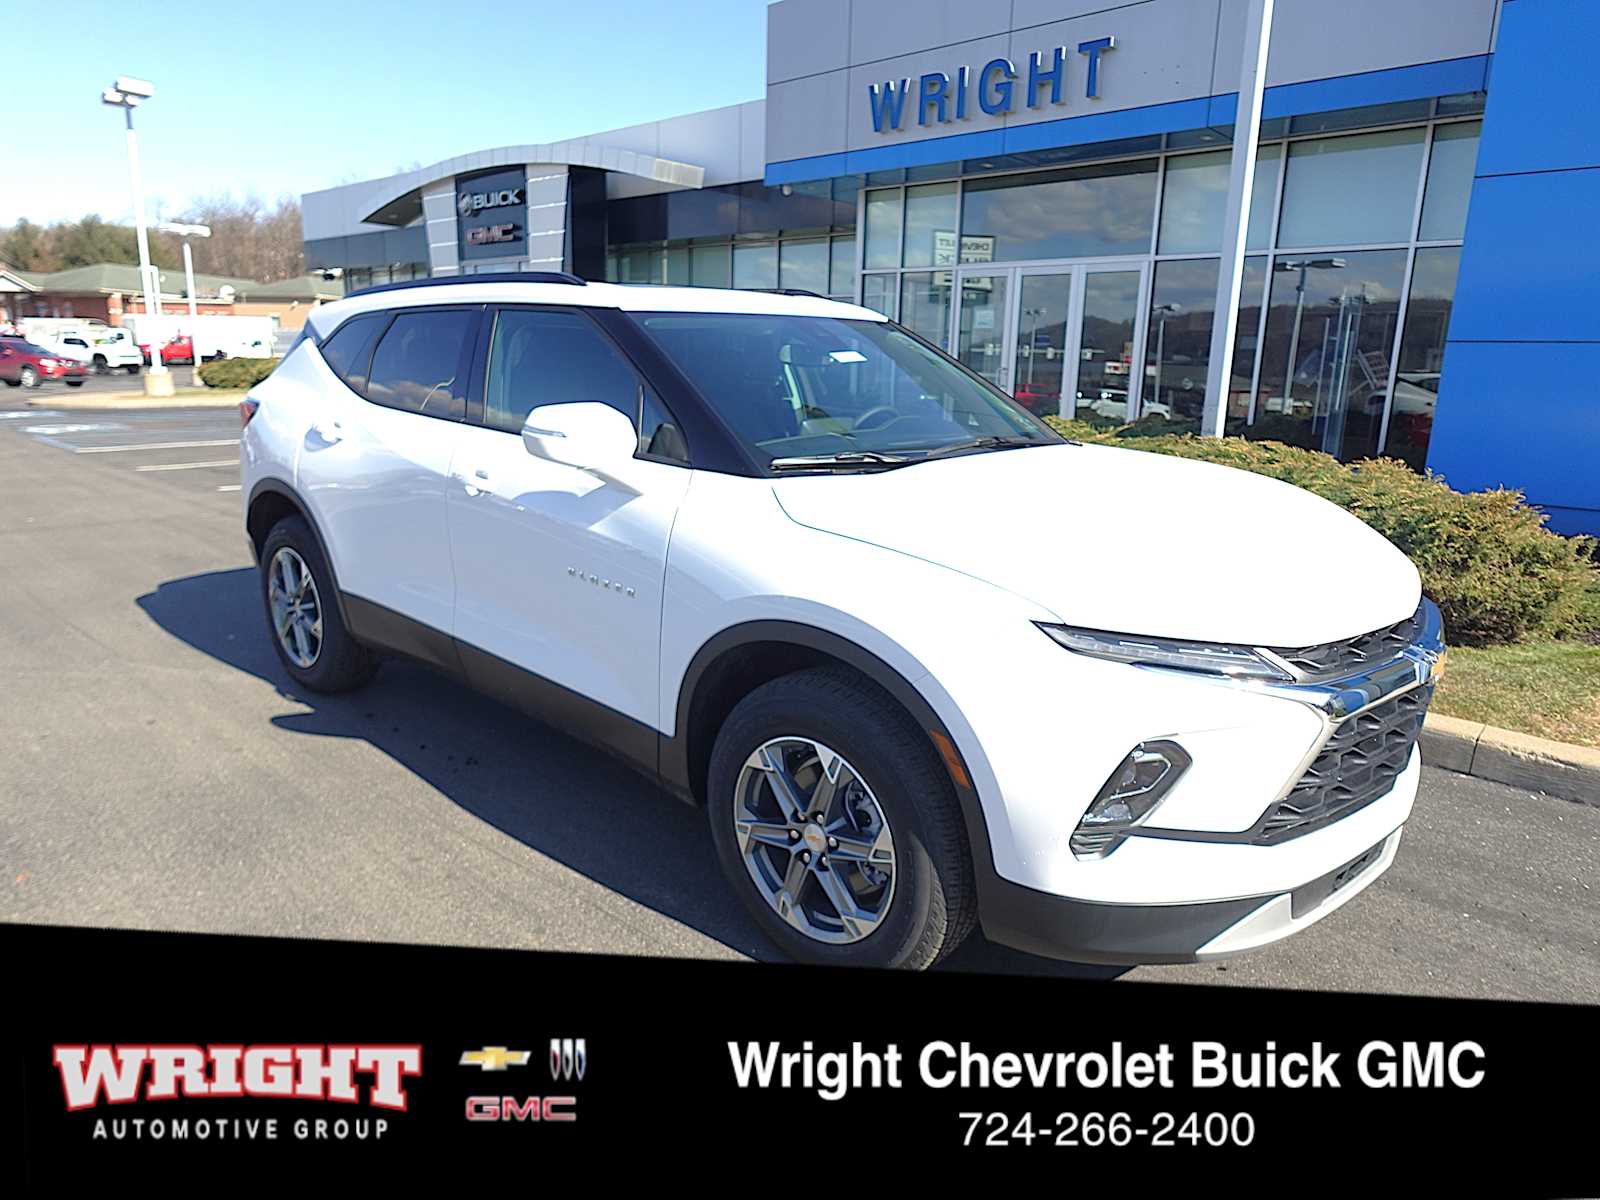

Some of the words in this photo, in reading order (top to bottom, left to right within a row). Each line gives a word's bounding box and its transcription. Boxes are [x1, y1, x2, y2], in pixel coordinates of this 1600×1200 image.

[868, 36, 1115, 132] WRIGHT
[473, 189, 521, 209] BUICK
[466, 224, 514, 245] GMC
